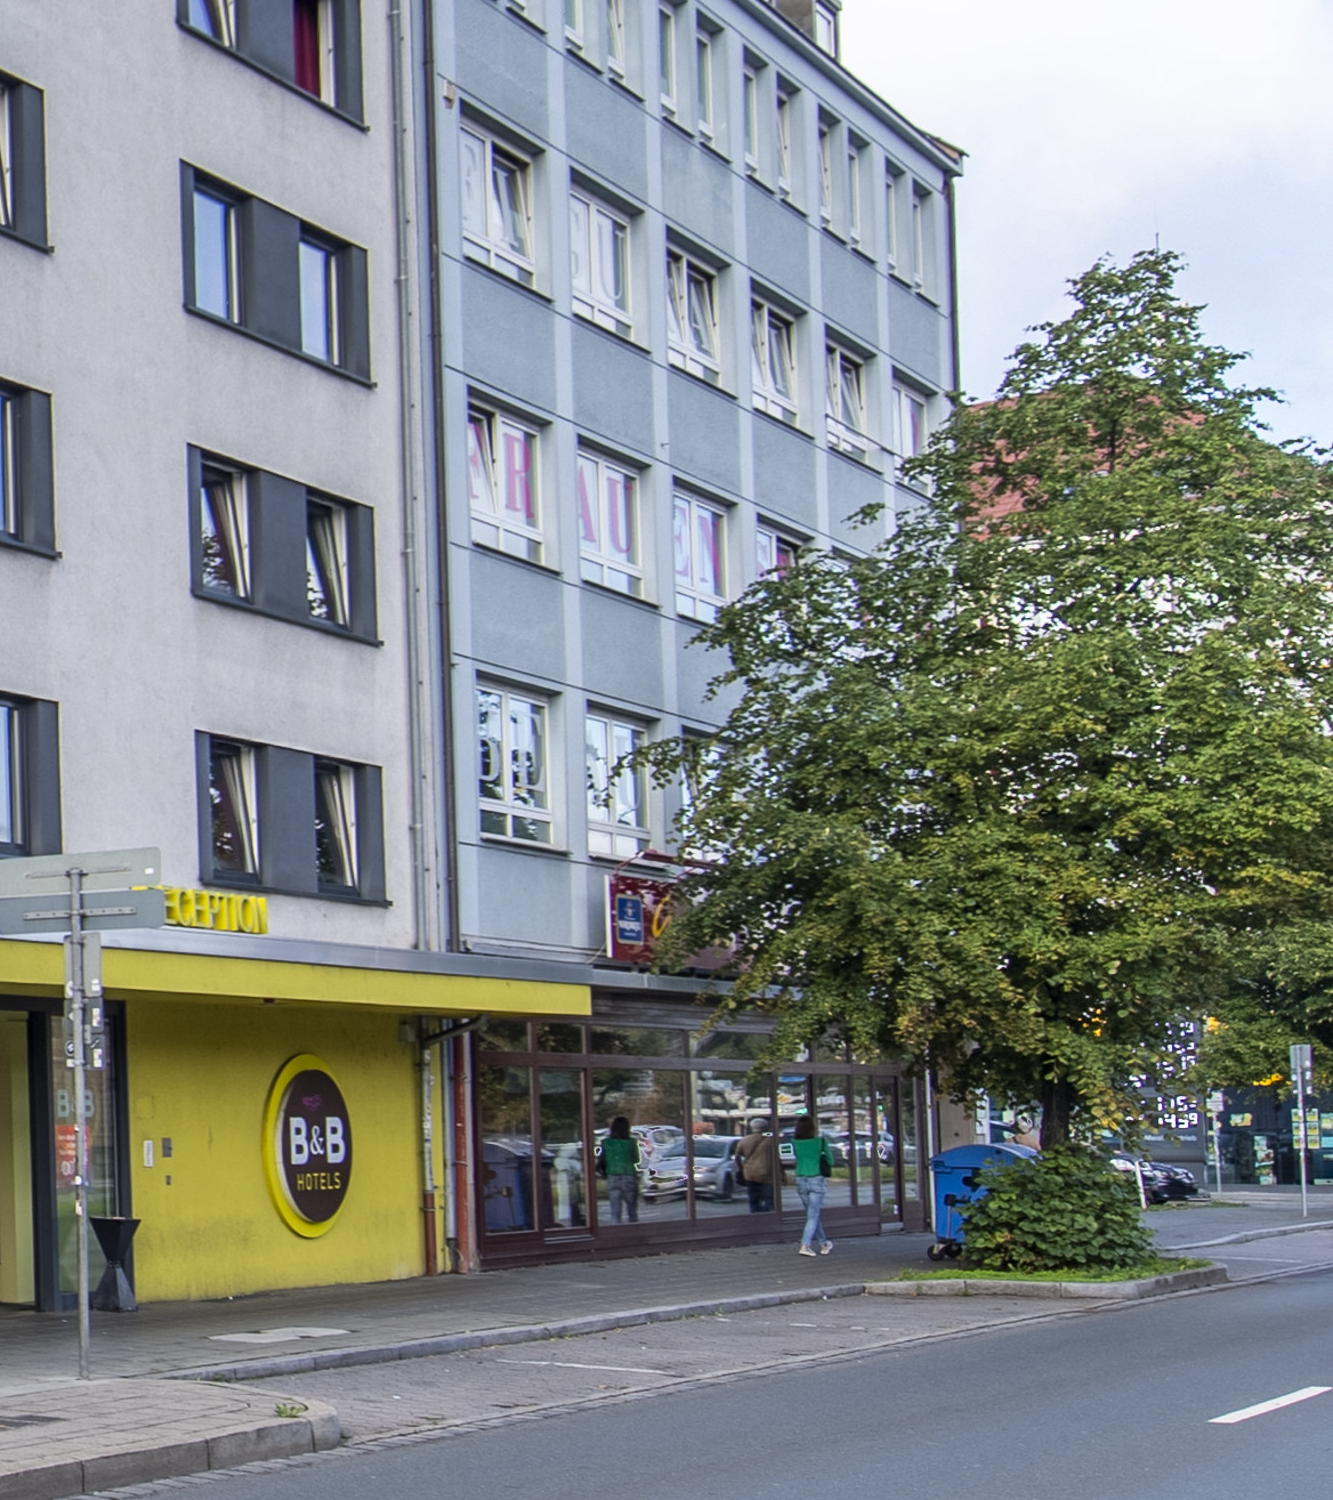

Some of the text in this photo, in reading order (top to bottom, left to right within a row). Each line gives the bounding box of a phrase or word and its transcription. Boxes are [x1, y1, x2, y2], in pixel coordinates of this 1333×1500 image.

[130, 884, 269, 935] ECEPTION
[57, 1089, 95, 1118] BB
[289, 1116, 346, 1165] B&B
[296, 1172, 341, 1191] HOTELS
